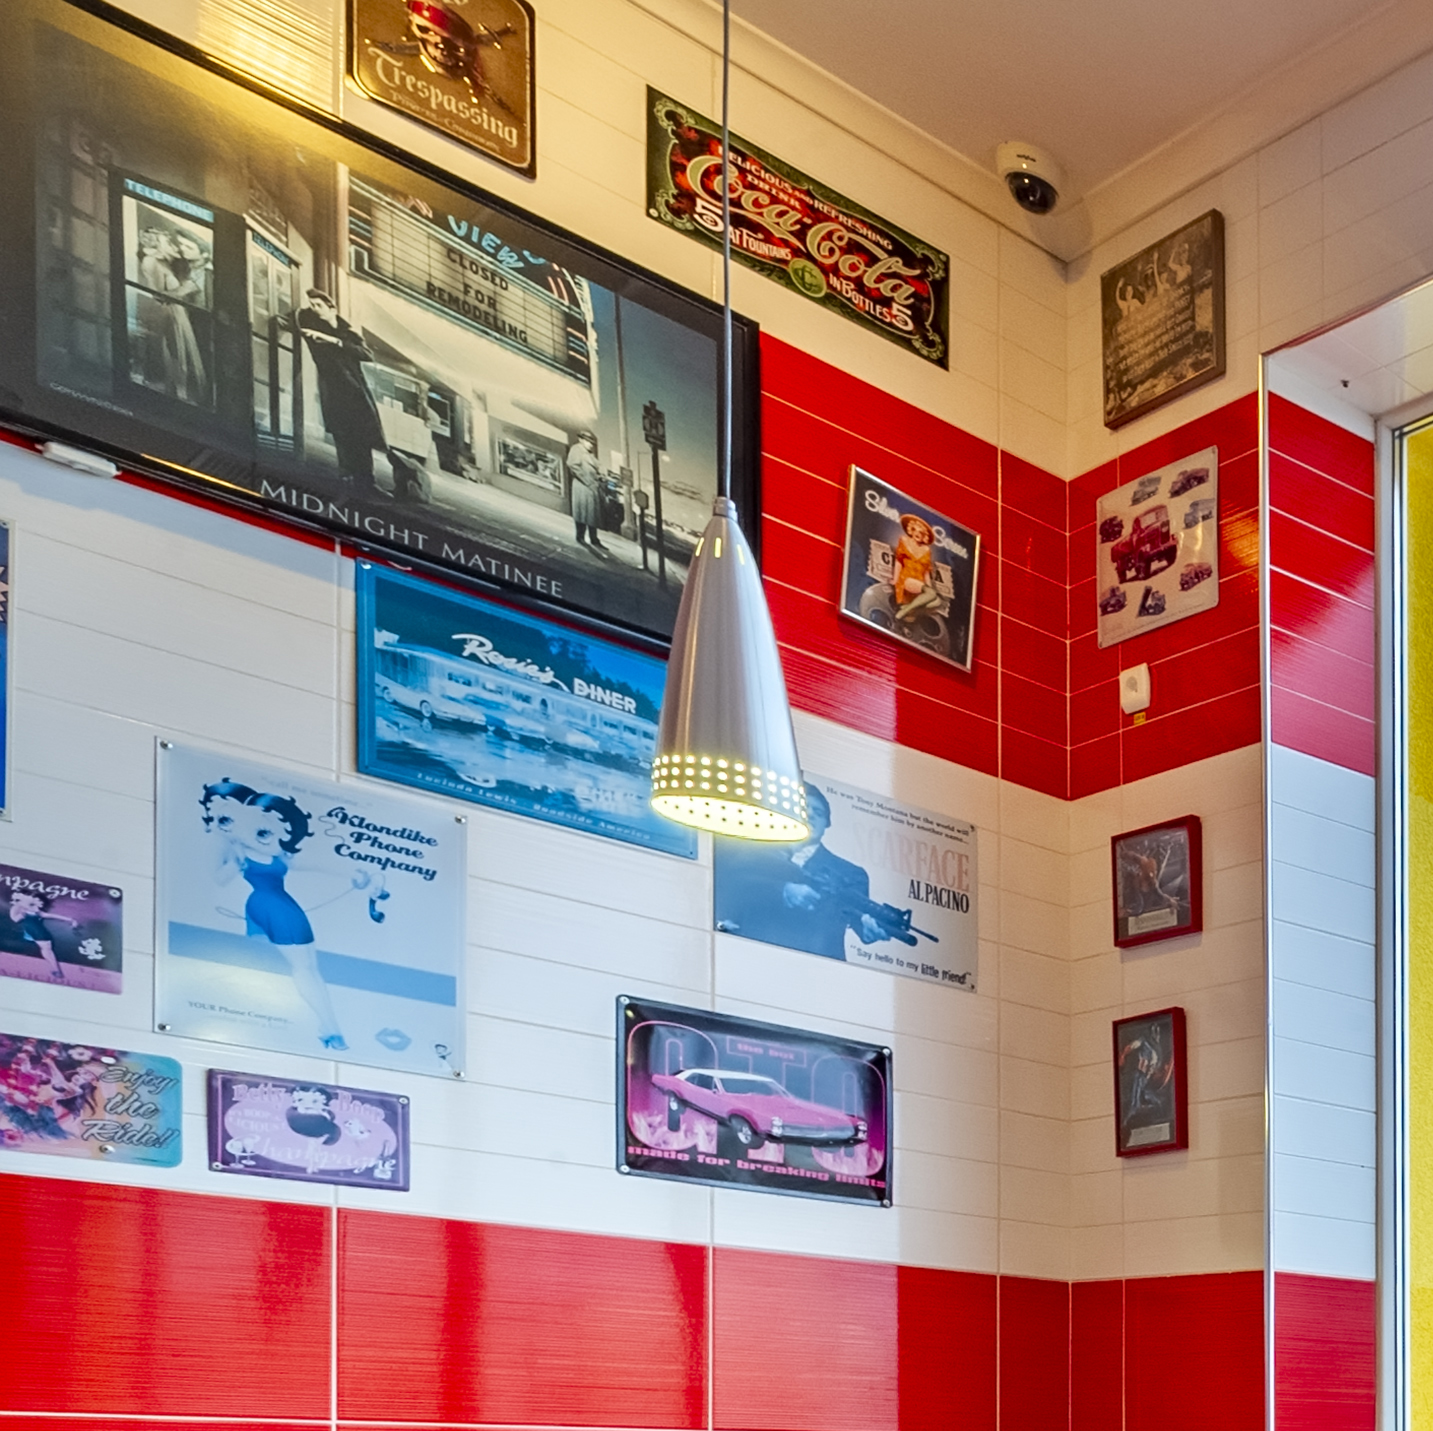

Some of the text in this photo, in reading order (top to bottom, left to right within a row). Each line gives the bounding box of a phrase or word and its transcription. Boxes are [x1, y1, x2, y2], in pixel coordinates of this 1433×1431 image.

[367, 46, 518, 149] Trespassing
[124, 178, 215, 223] TELEPHONE
[746, 173, 802, 209] DRINK
[447, 215, 524, 268] VIEW
[687, 155, 921, 304] Coca-Cola
[814, 199, 893, 250] REFRESHING
[446, 248, 509, 291] CLOSED
[425, 281, 529, 344] REMODELING
[463, 283, 497, 311] FOR
[260, 479, 563, 598] MIDNIGHT MATINEE
[451, 633, 637, 714] Rosie's DINER
[326, 806, 439, 847] Klondike
[533, 803, 594, 825] Roadside
[856, 795, 874, 808] Tony
[876, 802, 908, 818] Montana
[910, 811, 921, 822] but
[923, 816, 934, 826] the
[334, 843, 438, 881] Company
[349, 831, 425, 859] Phone
[852, 819, 969, 893] SCARFACE
[908, 878, 970, 914] AL PACINO
[875, 952, 894, 965] hello
[896, 957, 905, 968] to
[906, 961, 919, 973] my
[921, 962, 940, 979] little
[99, 1065, 180, 1095] Enjoy
[232, 1083, 292, 1108] Betty
[103, 1091, 160, 1119] the
[628, 1146, 886, 1188] made for breaking limits
